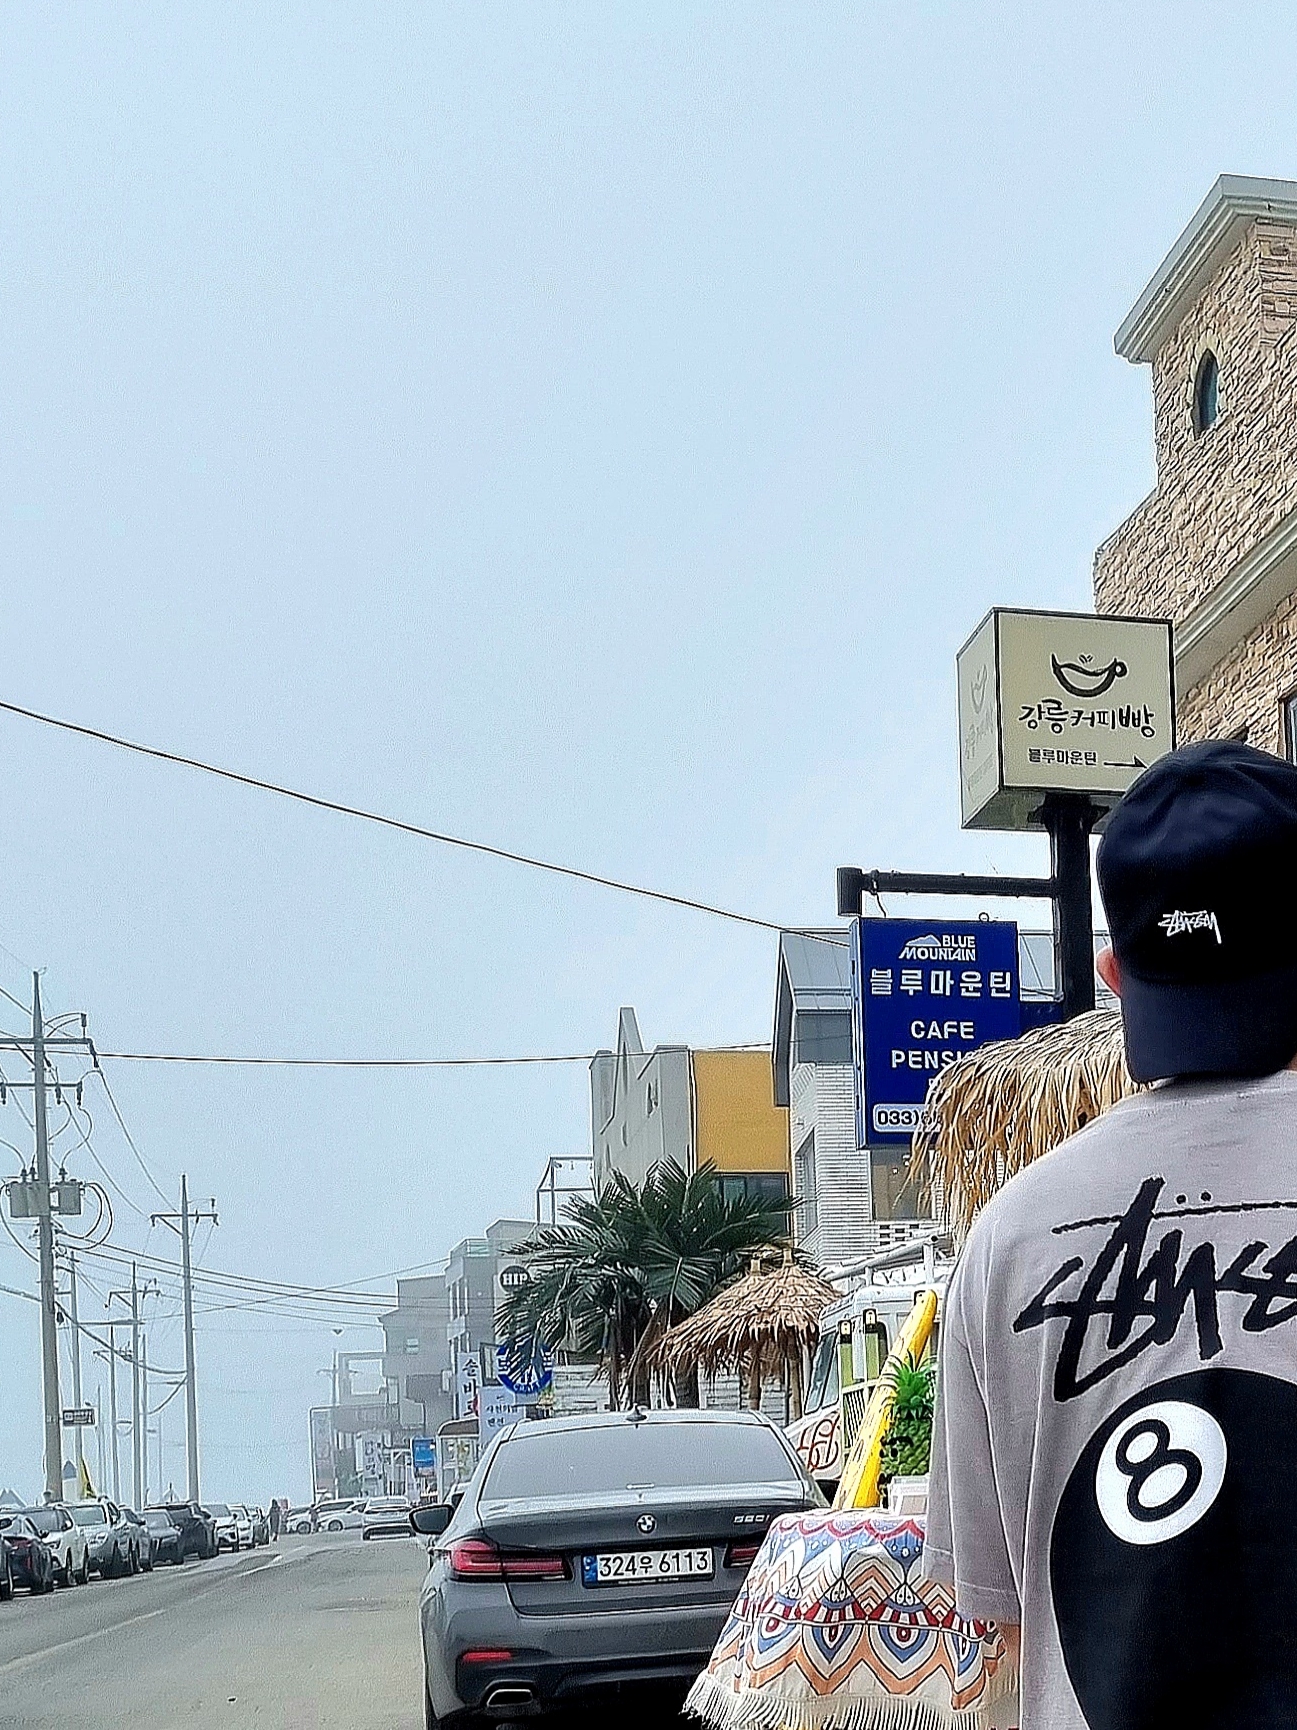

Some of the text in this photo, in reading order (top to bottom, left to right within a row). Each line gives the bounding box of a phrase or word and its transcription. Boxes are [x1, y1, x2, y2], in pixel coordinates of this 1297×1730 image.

[1019, 699, 1155, 737] 강릉커피빵
[1028, 748, 1097, 766] 블루마운틴
[942, 934, 976, 948] BLUE
[899, 947, 976, 961] MOUNTAIN
[870, 968, 1011, 998] 블루마운틴
[910, 1020, 975, 1040] CAFE
[502, 1273, 528, 1286] HIP
[1115, 1418, 1203, 1523] 8
[600, 1550, 709, 1577] 324우 6113
